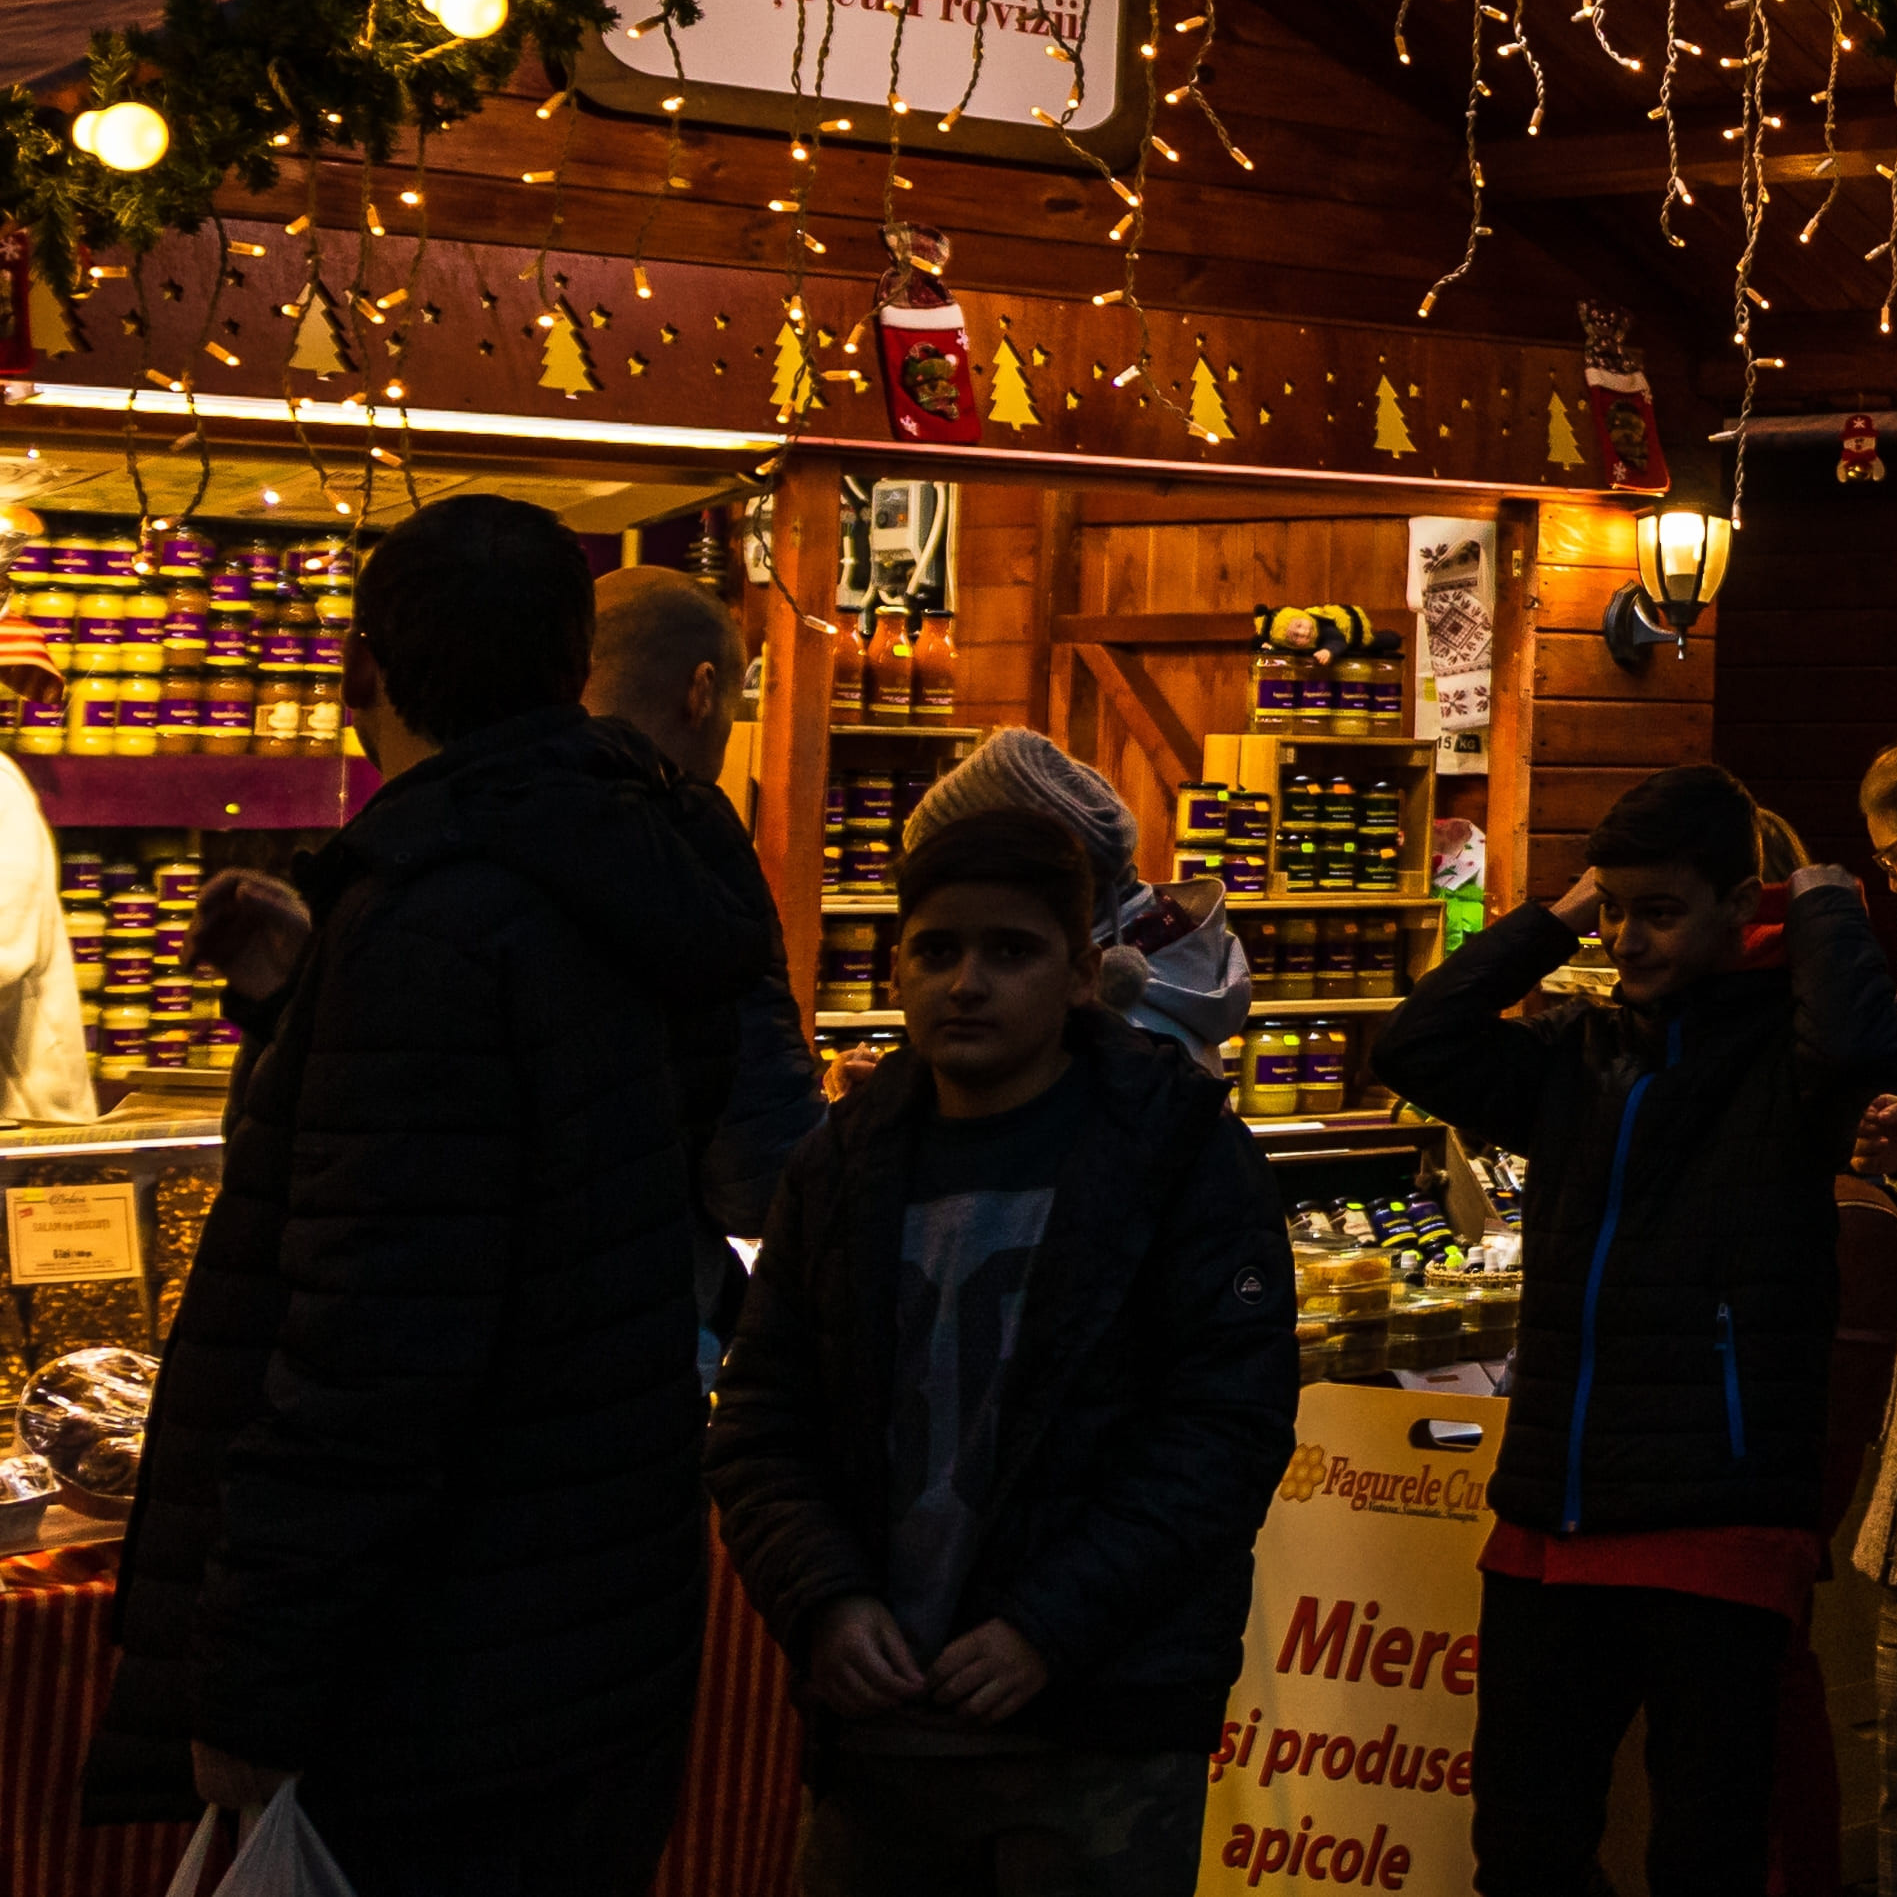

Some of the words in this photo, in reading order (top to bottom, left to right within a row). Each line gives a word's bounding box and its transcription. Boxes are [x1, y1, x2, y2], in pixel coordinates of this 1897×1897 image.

[1459, 739, 1476, 750] KG
[1322, 1456, 1441, 1511] Fagurele
[1275, 1595, 1479, 1695] Miere
[1259, 1723, 1474, 1796] produse
[1221, 1815, 1410, 1890] apicole
